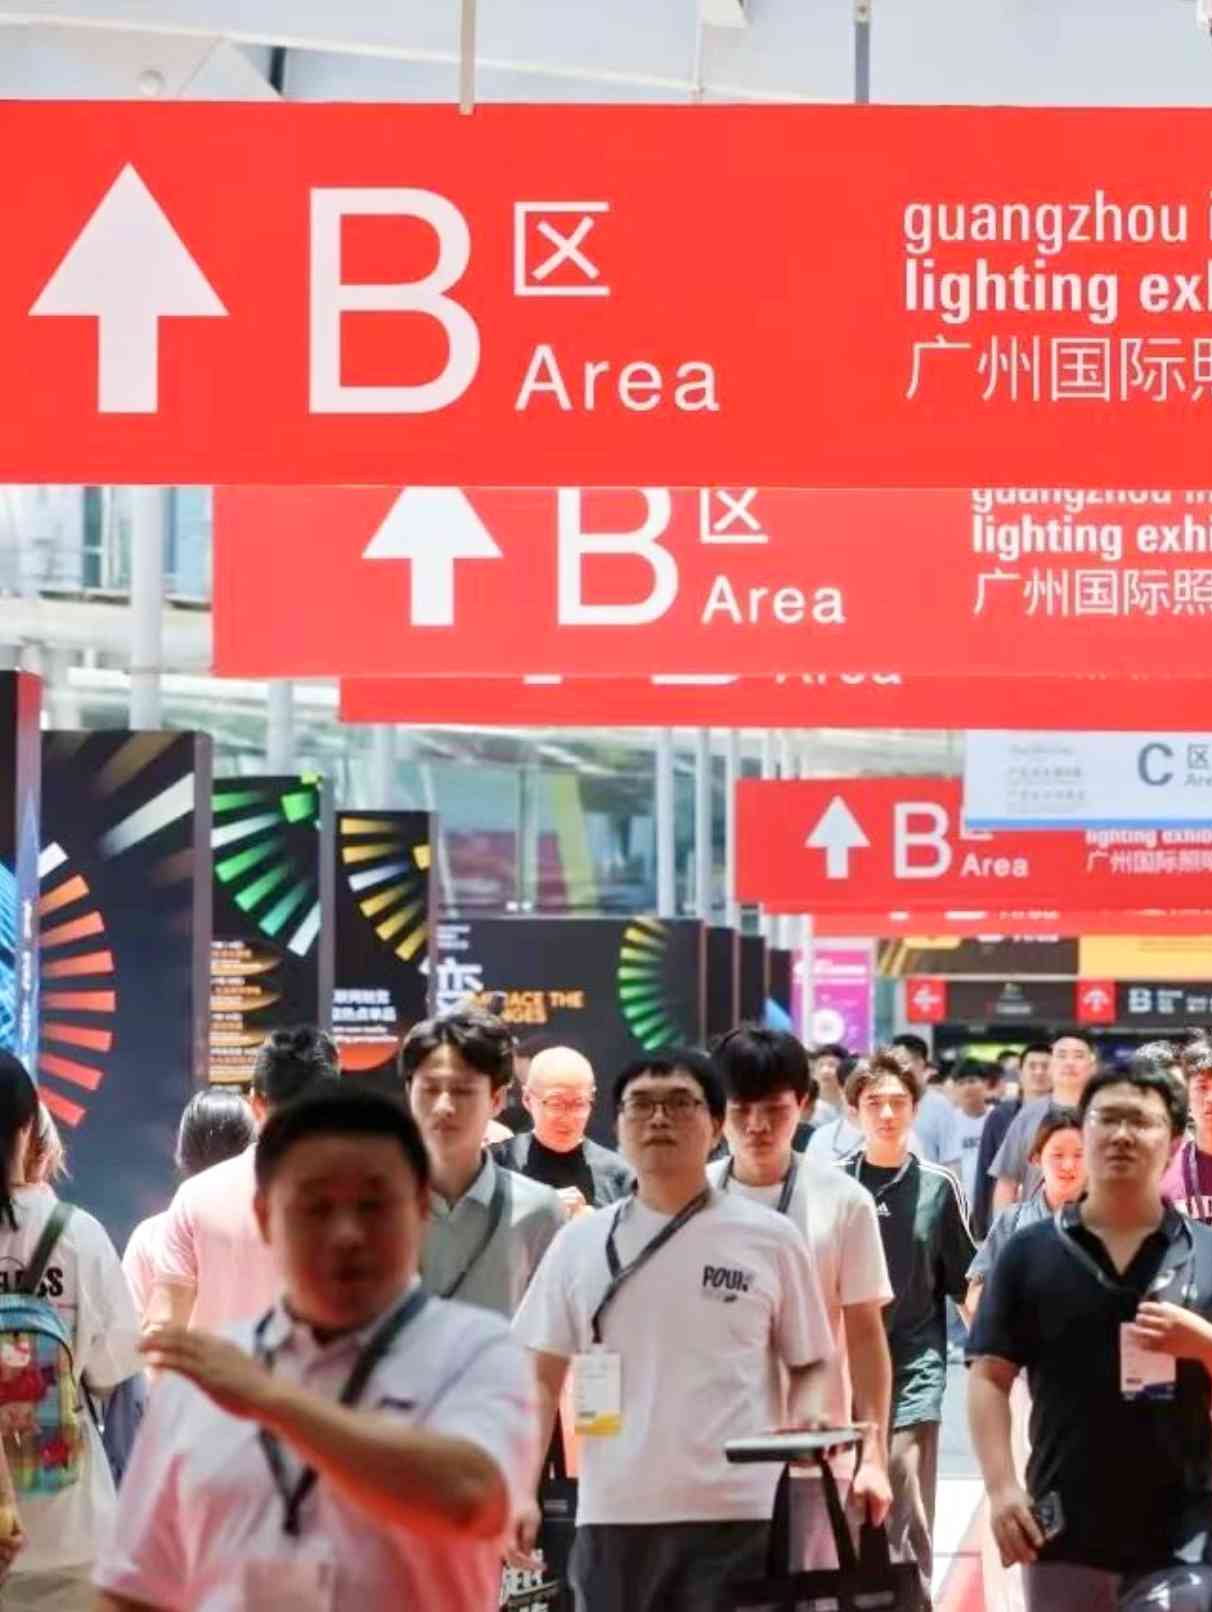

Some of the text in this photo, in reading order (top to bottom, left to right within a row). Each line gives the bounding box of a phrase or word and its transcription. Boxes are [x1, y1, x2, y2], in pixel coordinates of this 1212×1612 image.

[513, 201, 610, 297] 区
[903, 190, 1188, 254] guangzhou
[309, 187, 481, 414] B
[906, 259, 1118, 324] lighting
[515, 344, 720, 411] Area
[700, 489, 769, 543] 区
[972, 514, 1122, 561] lighting
[557, 489, 679, 625] B
[702, 575, 846, 624] Area
[1137, 742, 1175, 787] C
[893, 801, 953, 879] B
[960, 852, 1029, 877] Area
